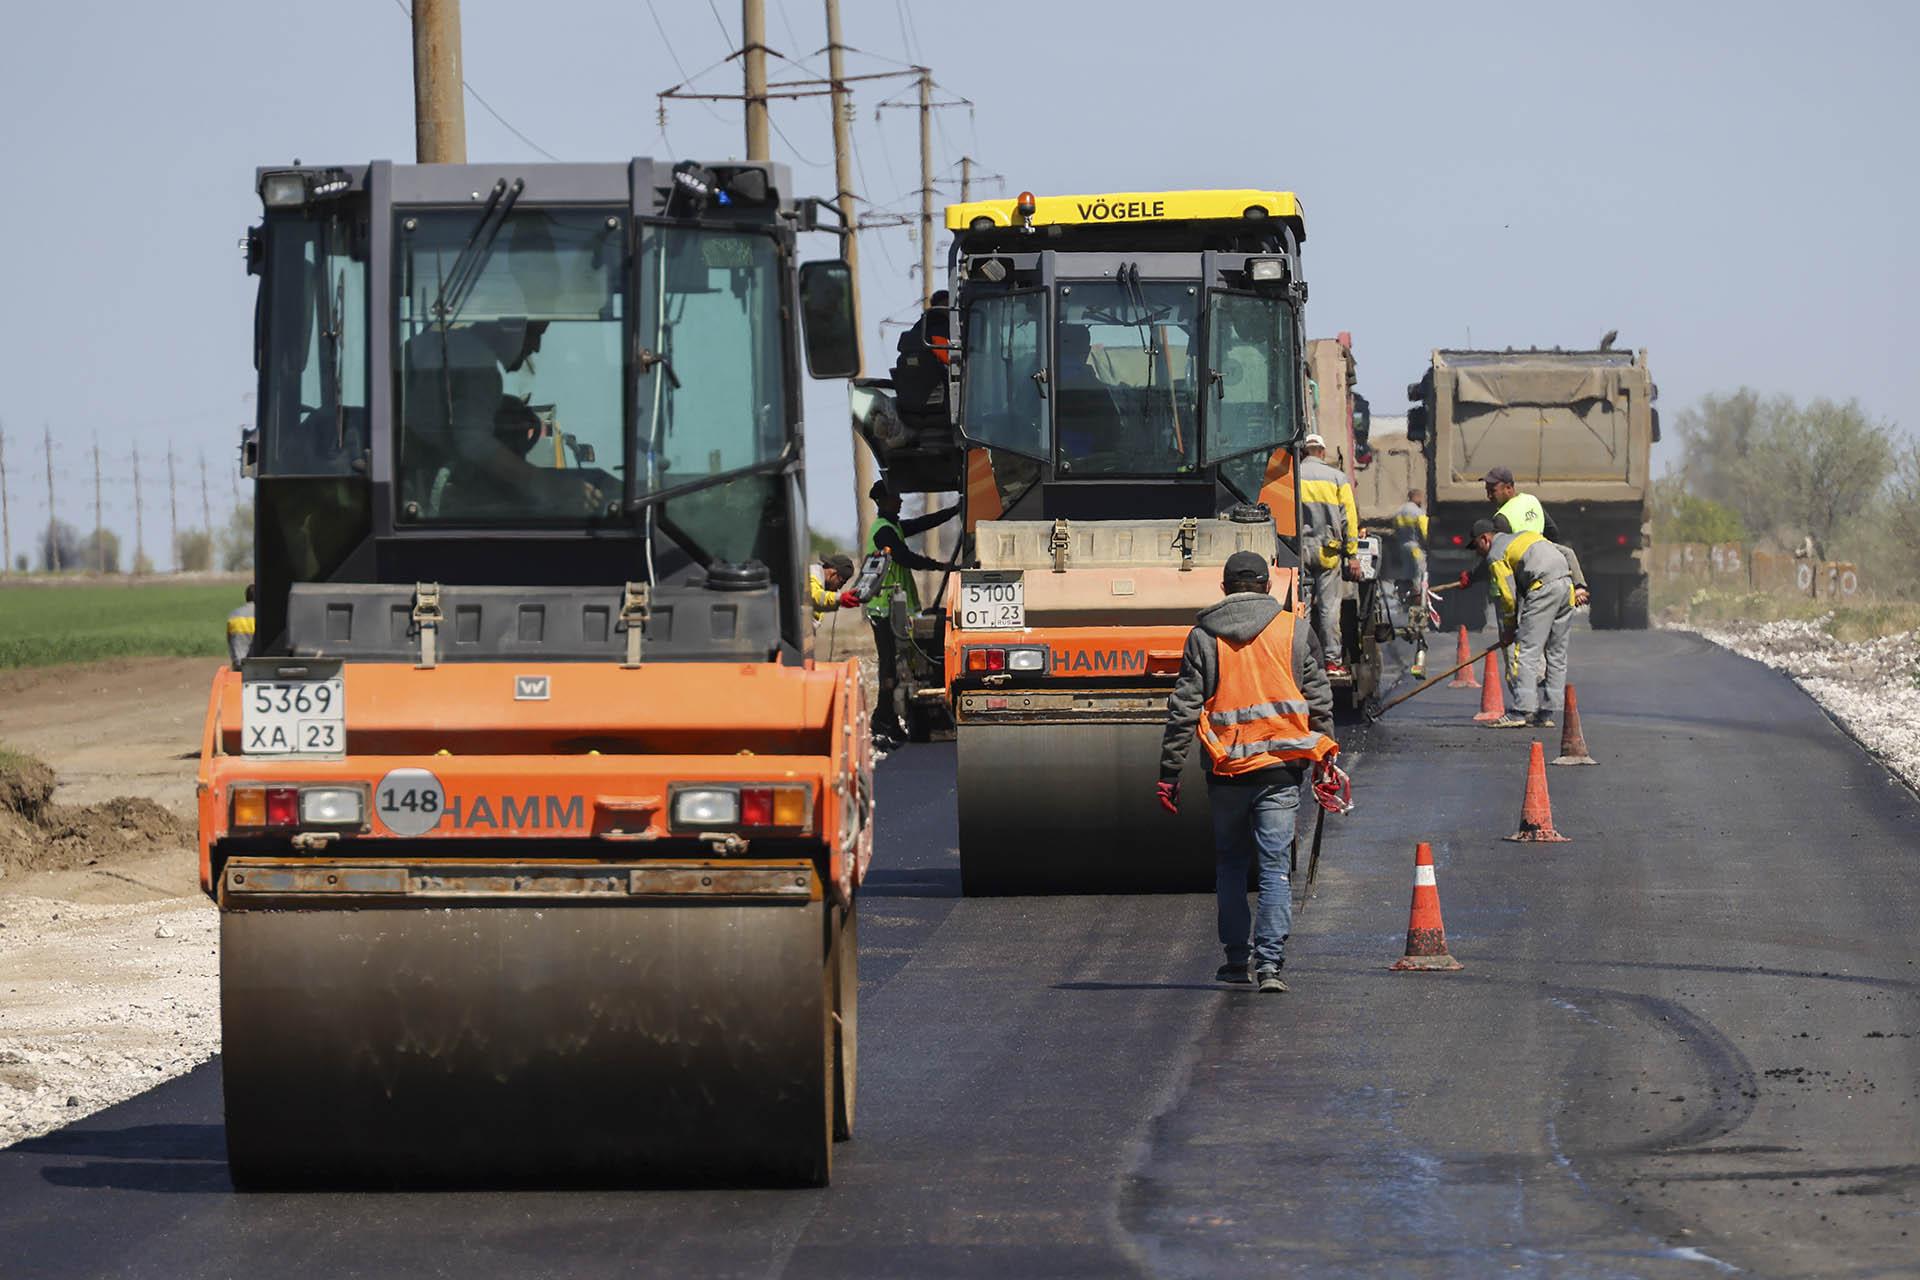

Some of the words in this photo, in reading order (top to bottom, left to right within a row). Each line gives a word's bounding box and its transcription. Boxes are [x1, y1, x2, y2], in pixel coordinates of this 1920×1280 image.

[1077, 198, 1165, 220] VÖGELE
[970, 584, 1016, 602] 5100
[1001, 605, 1019, 619] 23
[1052, 650, 1145, 671] HAMM
[256, 685, 331, 713] 5369
[307, 725, 335, 747] 23
[381, 788, 438, 813] 148
[433, 795, 585, 829] HAMM
